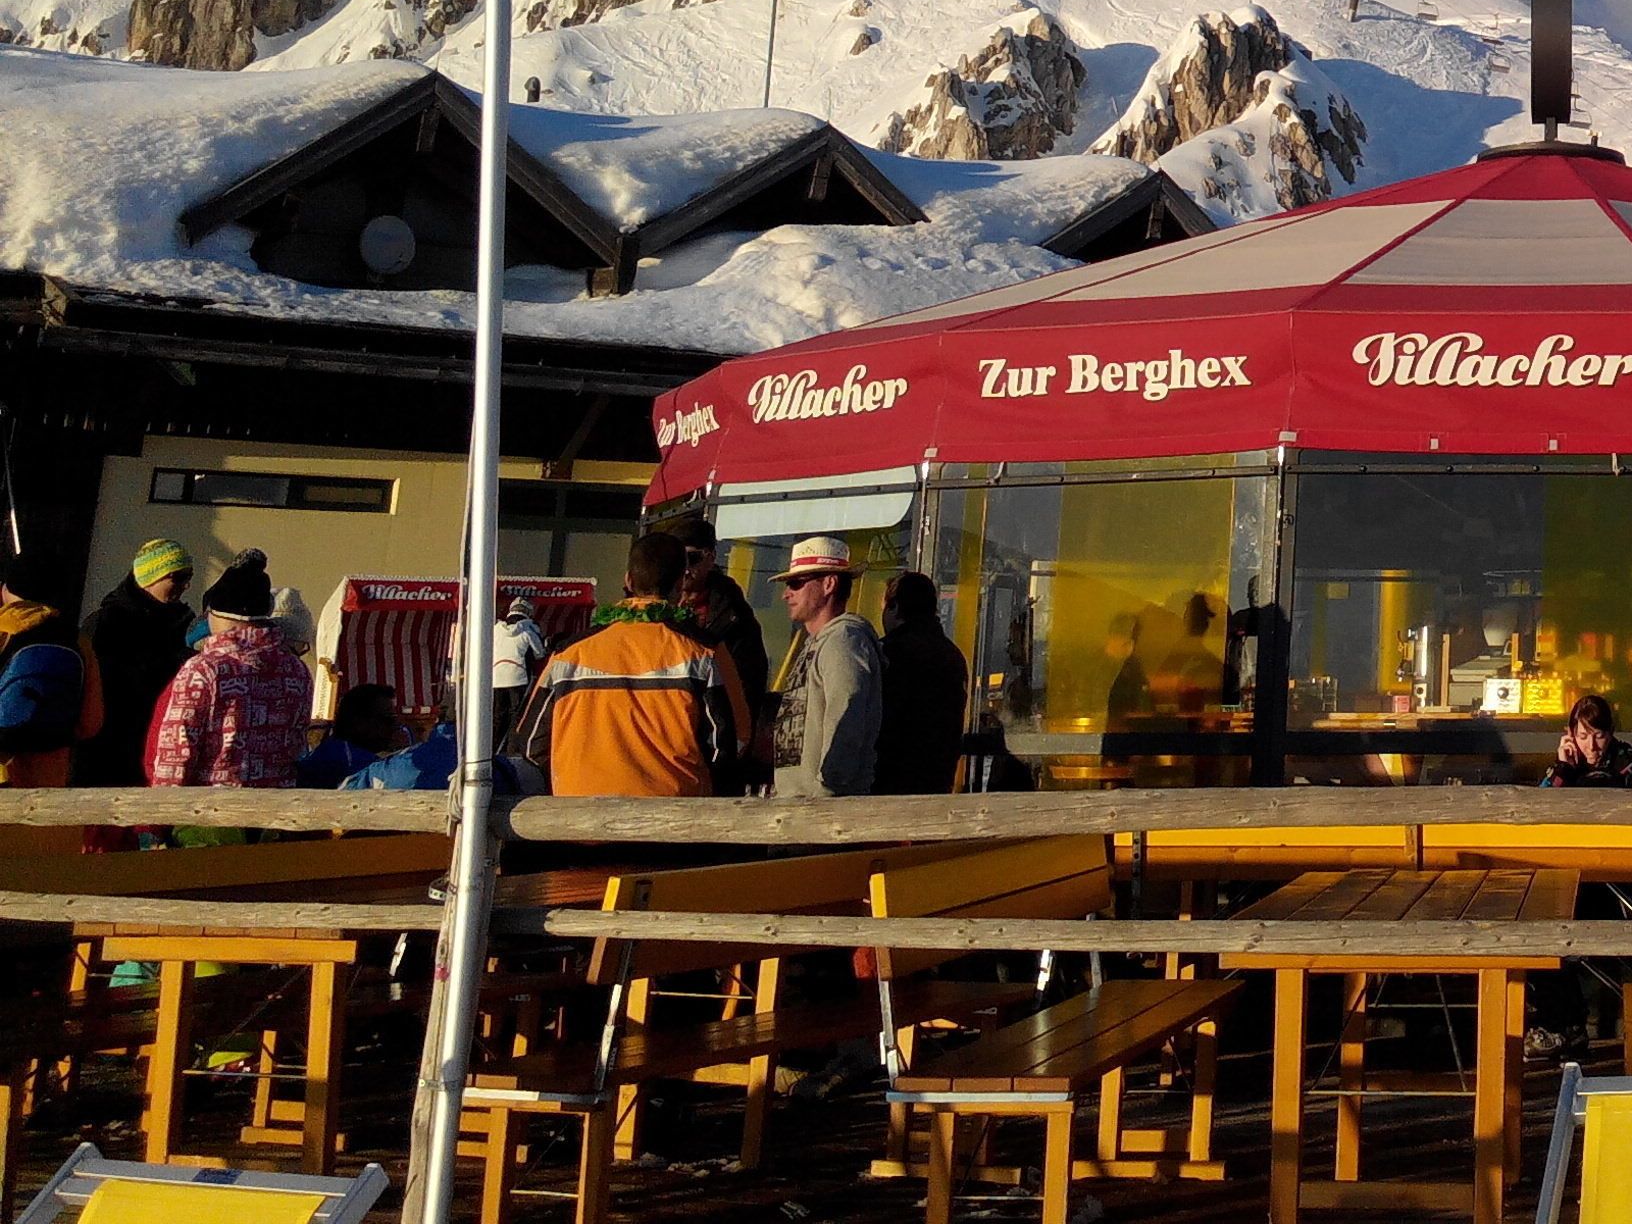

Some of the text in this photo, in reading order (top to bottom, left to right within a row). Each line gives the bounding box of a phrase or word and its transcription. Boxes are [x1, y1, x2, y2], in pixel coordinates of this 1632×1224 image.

[747, 364, 908, 424] Villacher
[977, 349, 1252, 402] Zur Berghex
[676, 401, 720, 448] Berghex
